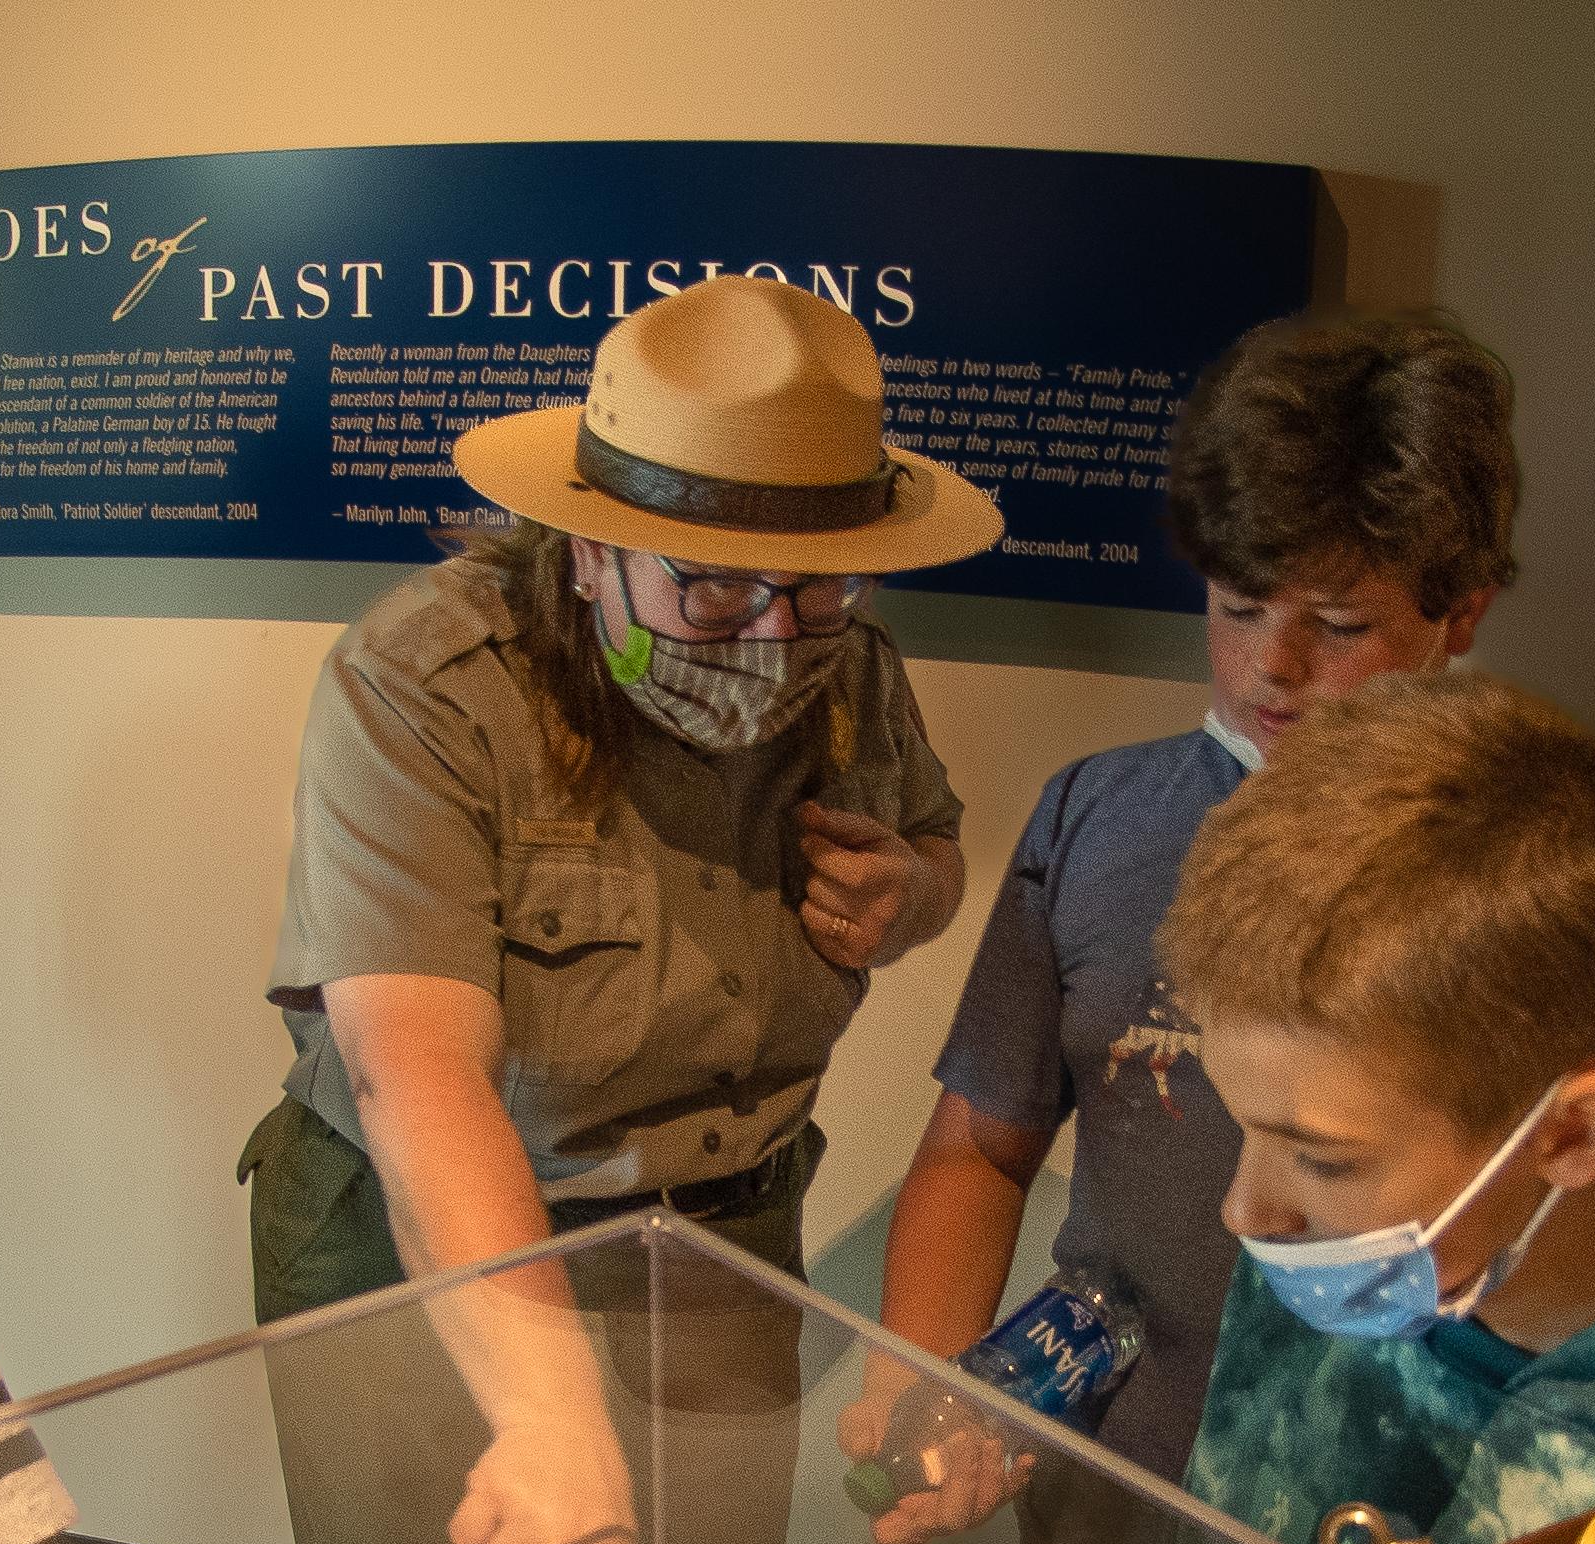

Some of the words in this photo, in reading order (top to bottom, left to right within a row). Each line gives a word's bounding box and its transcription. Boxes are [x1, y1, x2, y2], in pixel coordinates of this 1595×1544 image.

[112, 216, 207, 322] of
[199, 262, 383, 321] PAST
[427, 260, 916, 328] DECISNS
[0, 353, 43, 370] Stanwix
[71, 351, 123, 368] reminder
[142, 353, 159, 370] my
[163, 348, 213, 369] heritage
[217, 347, 241, 364] and
[244, 347, 269, 367] why
[272, 350, 296, 365] we,
[331, 344, 386, 365] Recently
[401, 348, 452, 361] woman
[455, 344, 489, 361] from
[491, 344, 515, 361] the
[518, 345, 591, 365] Daughters
[2, 375, 24, 391] free
[27, 374, 66, 393] nation,
[69, 374, 98, 390] exist.
[134, 372, 169, 392] proud
[199, 370, 250, 387] honored
[331, 367, 399, 384] Revolution
[401, 368, 429, 384] told
[479, 368, 529, 385] Oneida
[532, 369, 560, 385] had
[331, 390, 395, 407] ancestors
[397, 390, 445, 407] behind
[460, 391, 500, 408] fallen
[504, 391, 530, 408] tree
[883, 379, 951, 400] ncestors
[80, 398, 130, 411] common
[134, 393, 174, 410] soldier
[193, 392, 214, 408] the
[217, 391, 279, 408] American
[52, 417, 98, 433] Palatine
[102, 416, 148, 432] German
[152, 416, 173, 435] boy
[193, 415, 210, 431] 15.
[215, 415, 233, 431] He
[235, 414, 277, 434] fought
[331, 413, 373, 434] saving
[399, 413, 422, 430] life.
[16, 439, 63, 455] freedom
[102, 438, 126, 458] only
[141, 438, 192, 458] fledgling
[195, 437, 238, 456] nation,
[332, 436, 360, 453] That
[362, 436, 399, 457] living
[401, 436, 435, 453] bond
[38, 461, 86, 476] freedom
[124, 460, 158, 476] home
[187, 460, 229, 479] family.
[349, 463, 386, 480] many
[21, 504, 58, 522] Smith,
[151, 504, 223, 522] descendant,
[227, 504, 258, 519] 2004
[346, 505, 393, 526] Marilyn
[396, 506, 429, 526] John,
[1026, 1320, 1090, 1394] SANI
